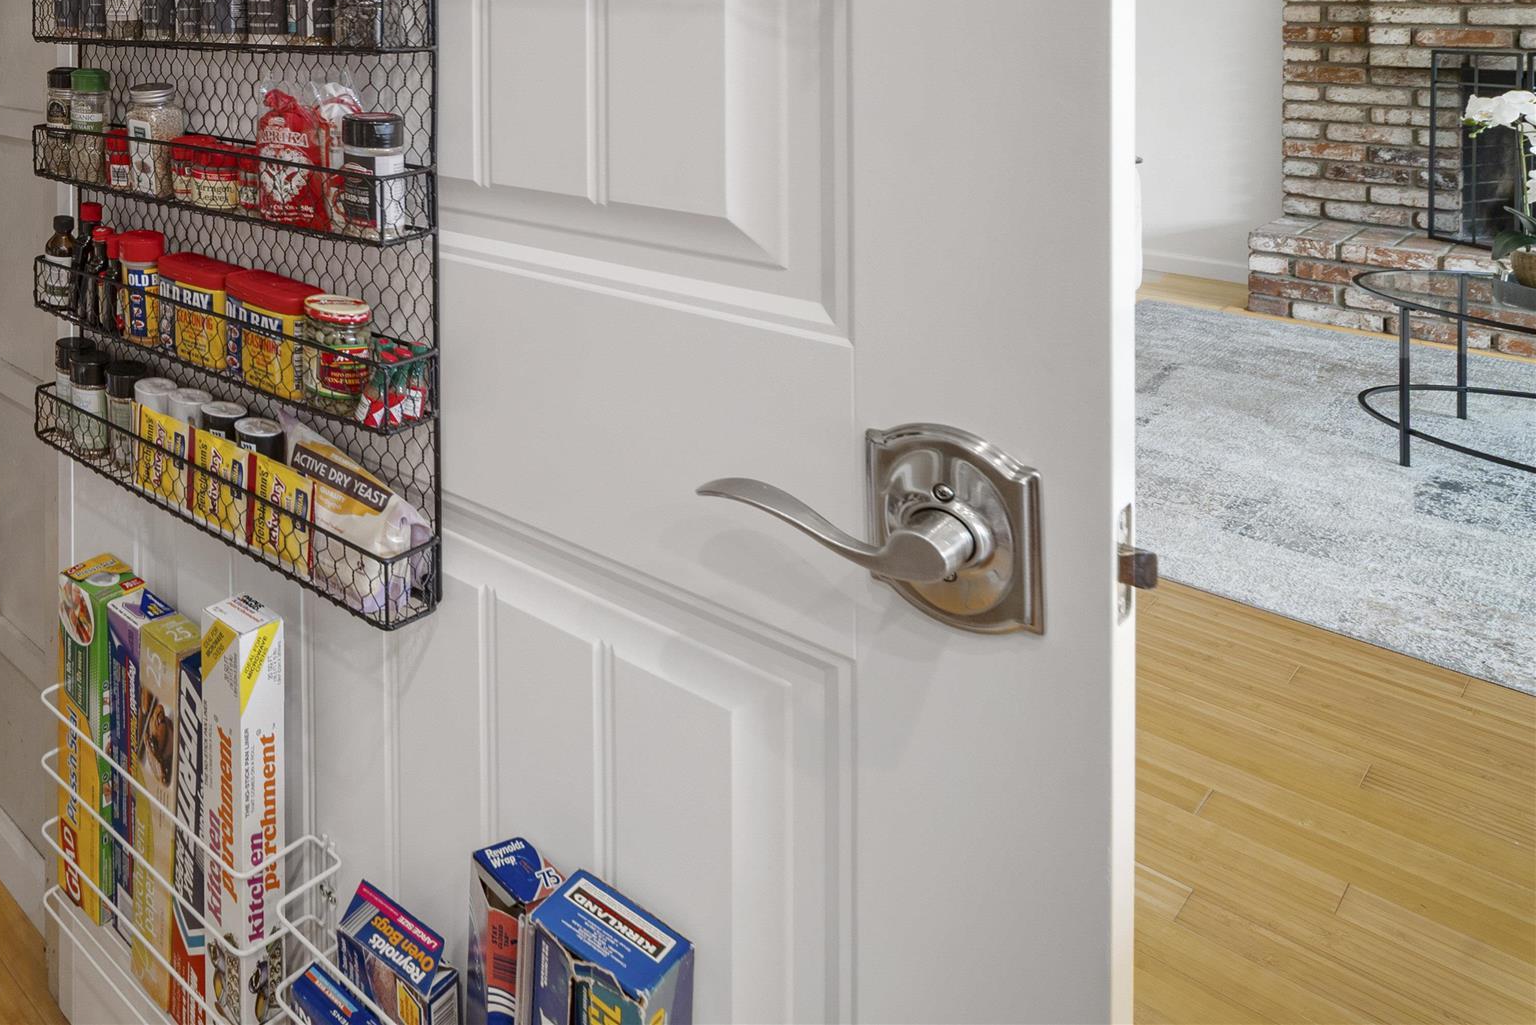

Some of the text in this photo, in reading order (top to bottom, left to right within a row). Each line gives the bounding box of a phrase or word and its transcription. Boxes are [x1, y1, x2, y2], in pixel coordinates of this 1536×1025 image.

[128, 273, 149, 287] OLD
[294, 451, 388, 508] ACTIVE DRY YEAST
[166, 626, 192, 642] 25
[147, 647, 163, 689] 25
[246, 635, 267, 680] MICROWAVE
[244, 766, 252, 801] NO-STICK
[216, 725, 238, 904] parchment
[259, 732, 280, 890] parchment
[63, 824, 81, 900] GLAD
[207, 808, 223, 925] kitchen
[485, 841, 525, 859] Reynolds
[490, 855, 516, 869] Wrap
[536, 869, 561, 888] 75
[371, 916, 435, 972] Oven Bags
[397, 915, 438, 950] LARGE SIZE
[574, 892, 659, 956] KIRKLAND
[368, 933, 426, 985] Reynolds
